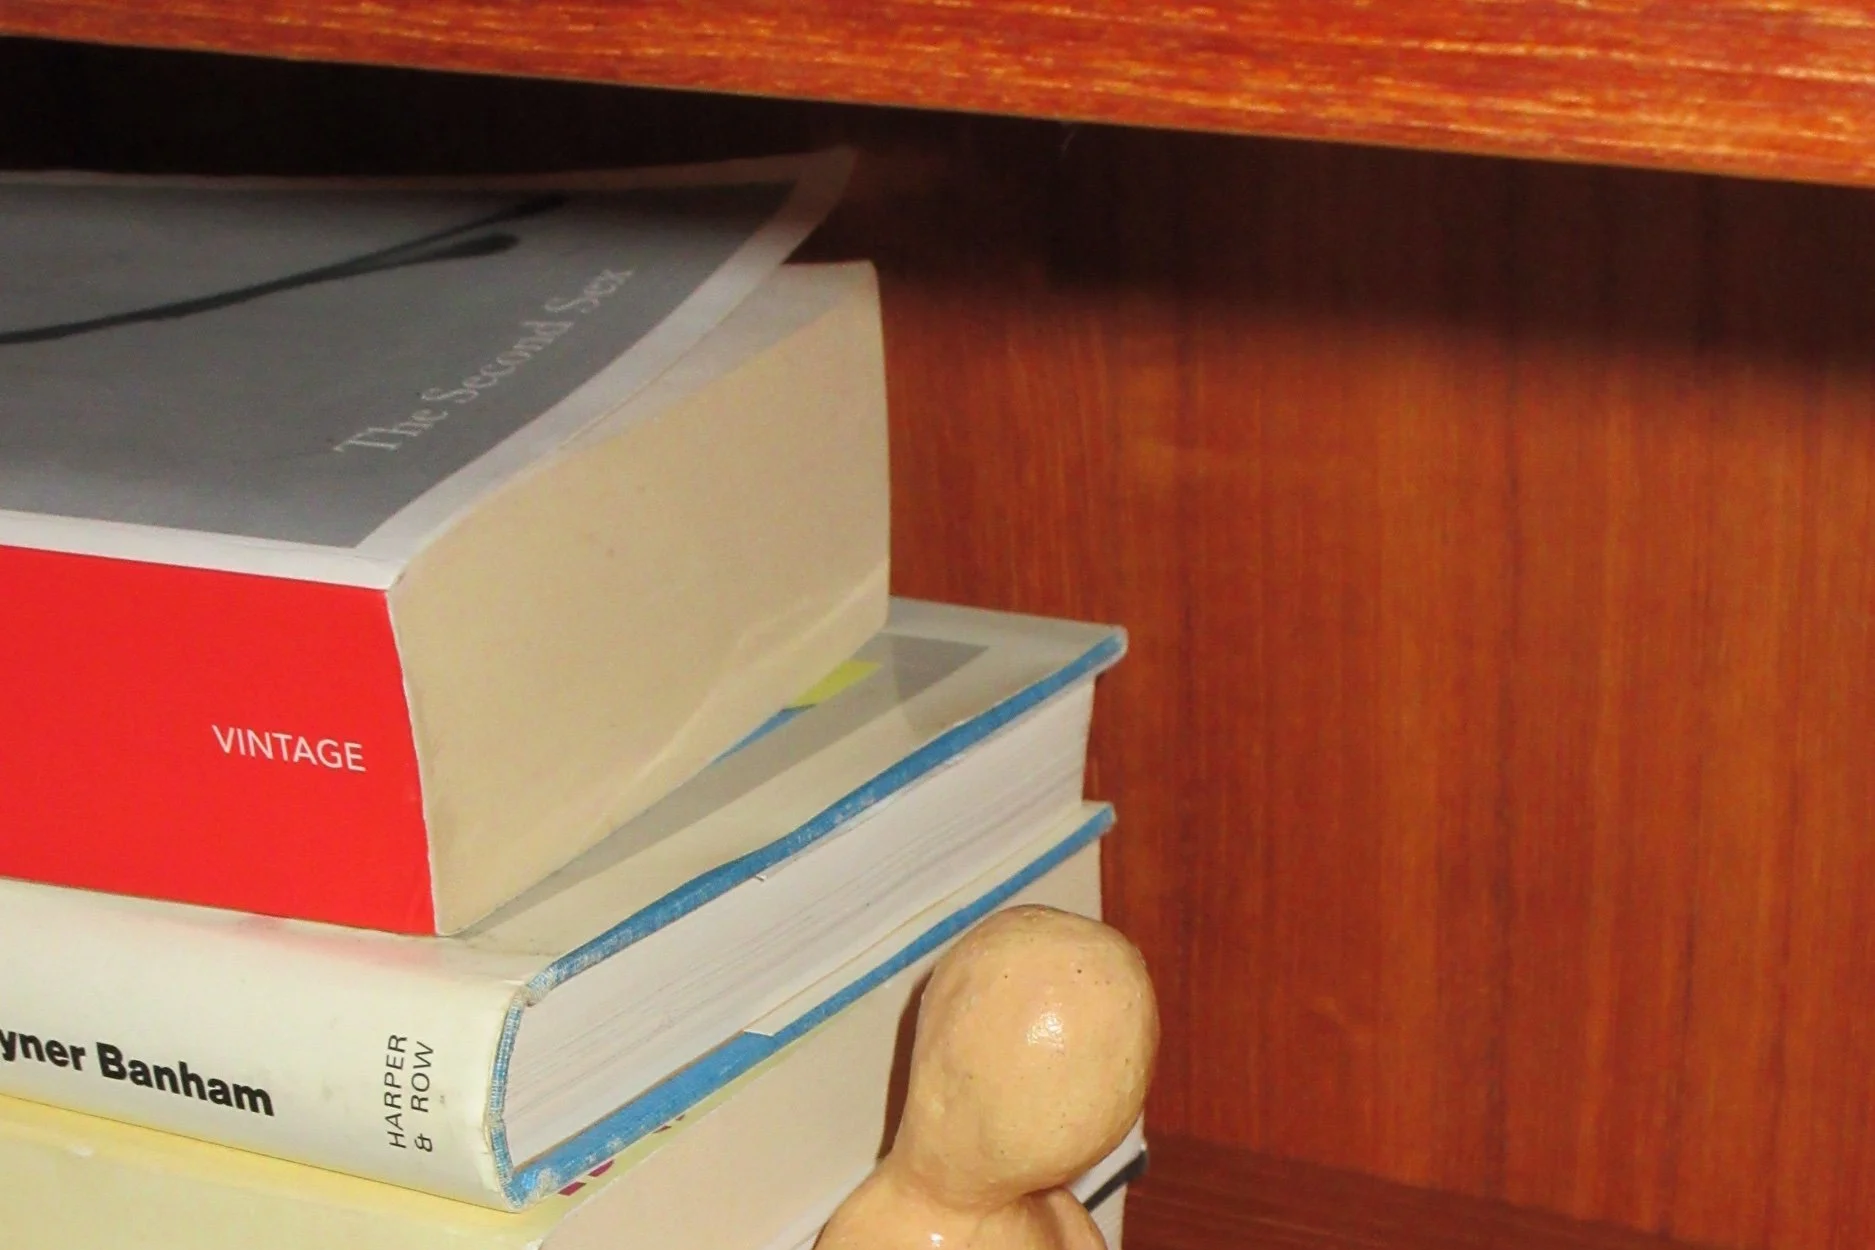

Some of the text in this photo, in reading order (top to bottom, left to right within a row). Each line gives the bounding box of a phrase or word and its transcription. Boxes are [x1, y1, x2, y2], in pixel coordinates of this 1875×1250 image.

[333, 269, 634, 451] The Second Sex
[211, 724, 366, 773] VINTAGE
[96, 1041, 275, 1117] Banham
[383, 1033, 408, 1150] HARPER
[410, 1040, 435, 1154] & ROW
